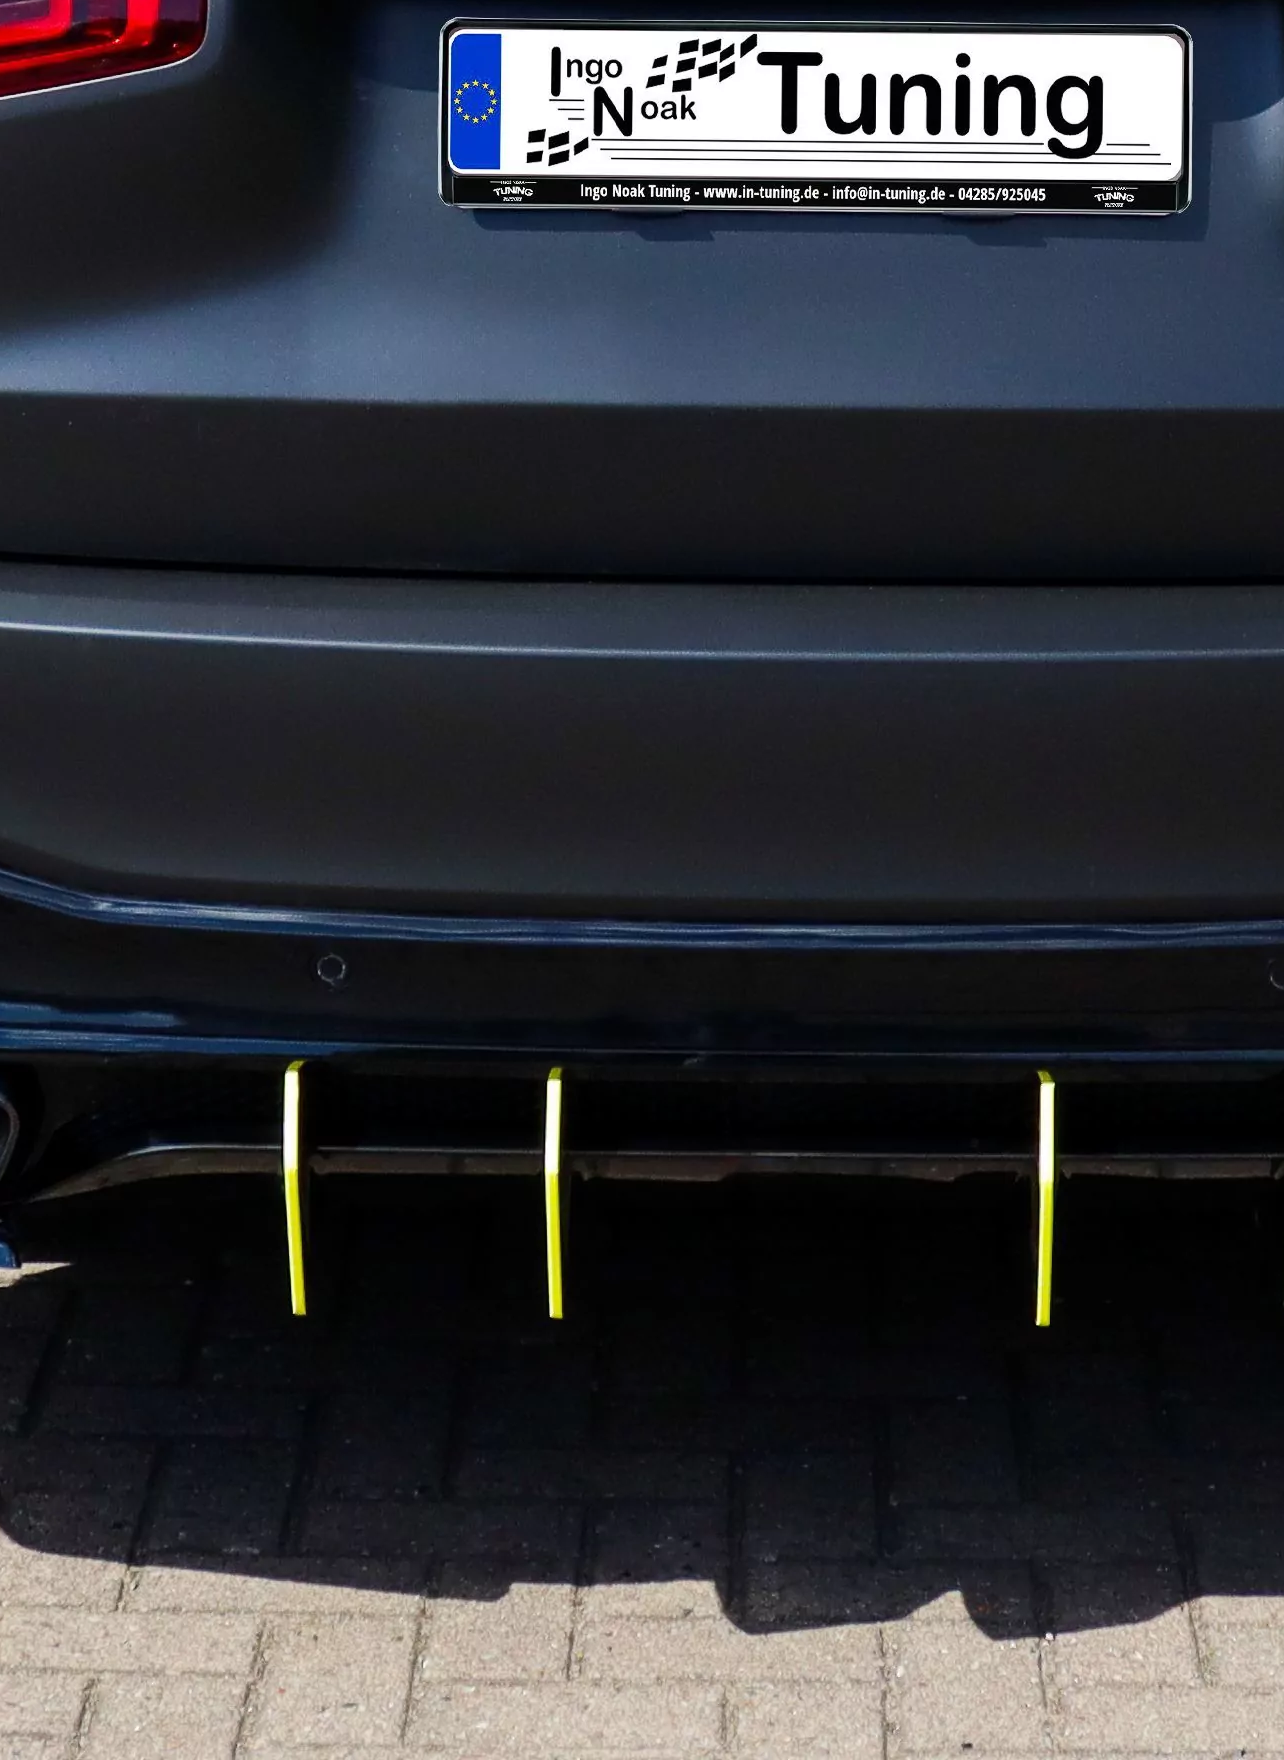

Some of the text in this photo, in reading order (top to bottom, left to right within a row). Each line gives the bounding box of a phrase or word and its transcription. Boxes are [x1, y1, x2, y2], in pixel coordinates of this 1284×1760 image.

[551, 46, 623, 97] Ingo
[756, 51, 1105, 158] Tuning
[580, 183, 608, 201] Ingo
[612, 183, 646, 198] Noak
[648, 184, 691, 202] Tuning
[703, 185, 820, 203] www.in-tuning.de
[832, 185, 946, 205] info@in-tuning.de
[958, 187, 1047, 202] 04285/925045
